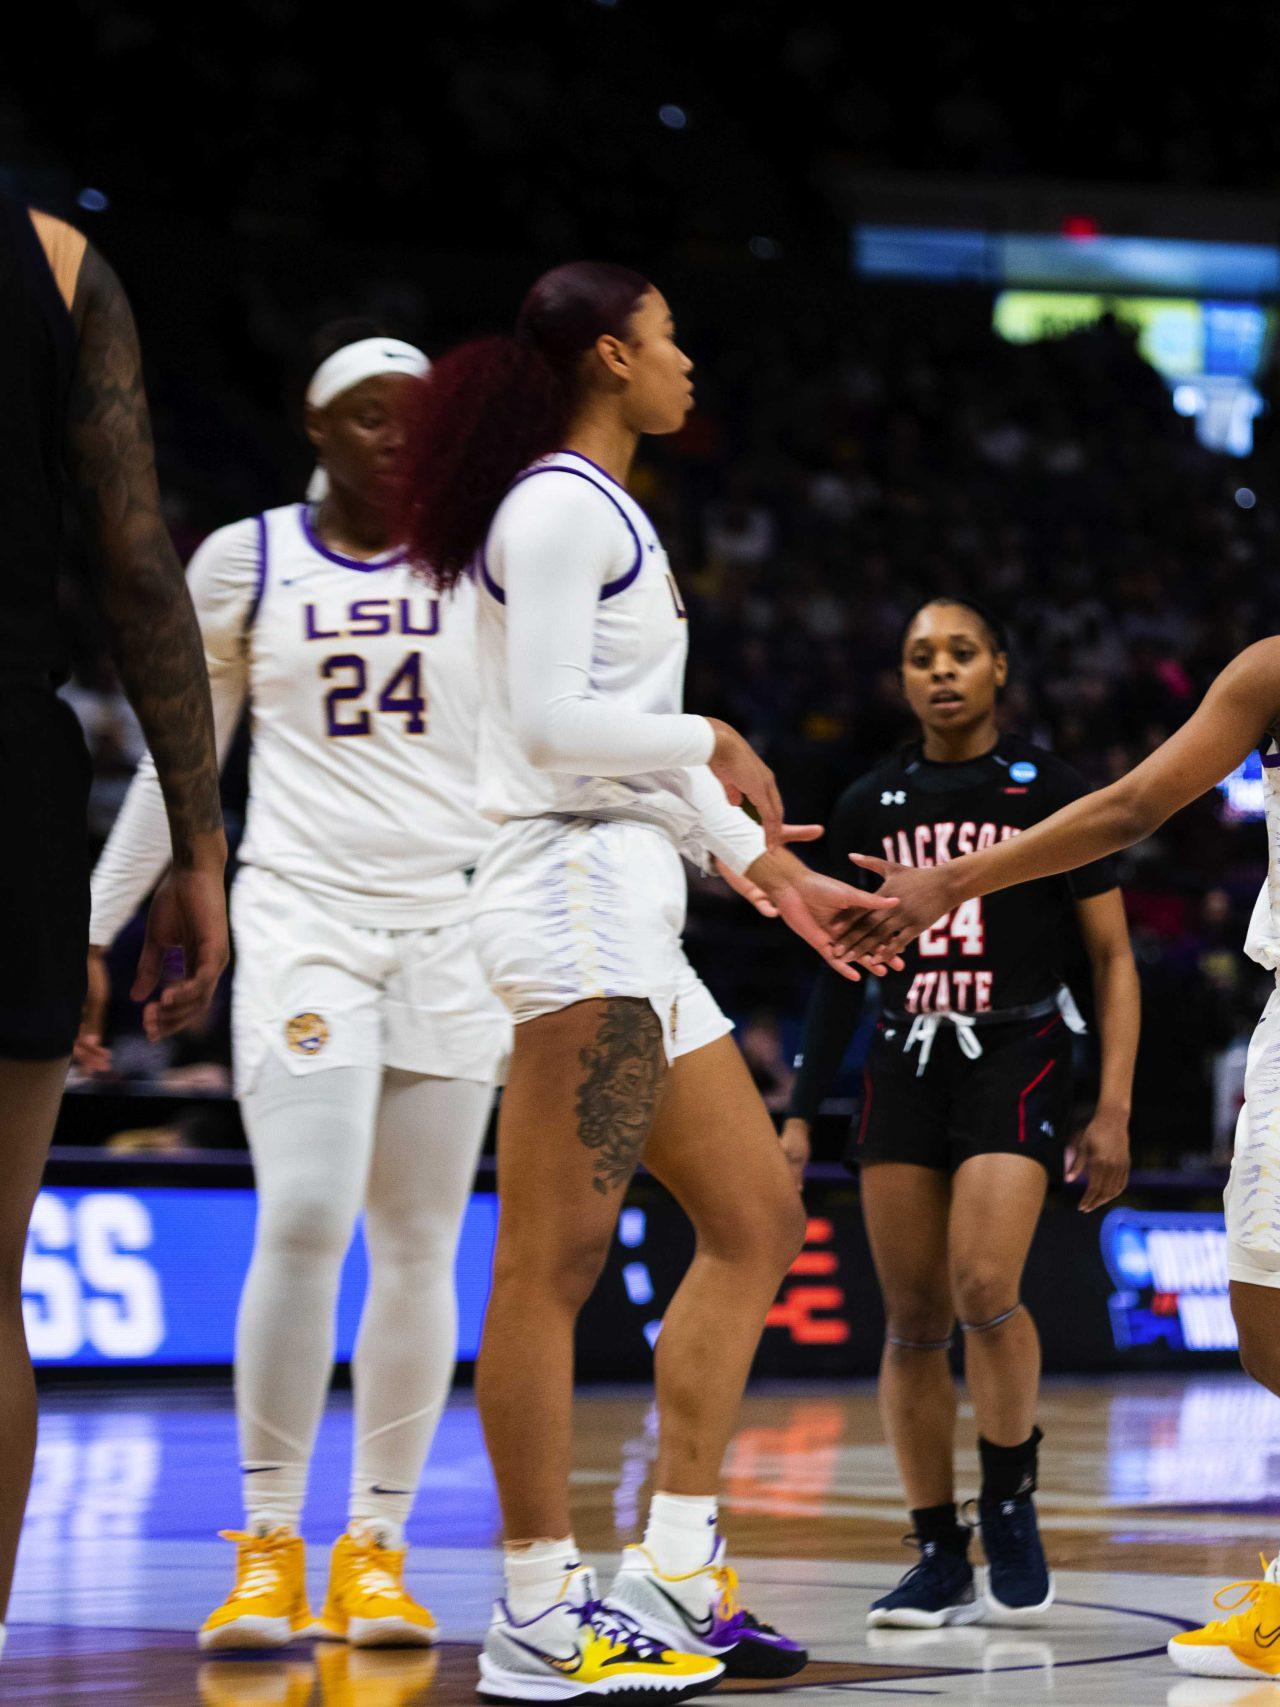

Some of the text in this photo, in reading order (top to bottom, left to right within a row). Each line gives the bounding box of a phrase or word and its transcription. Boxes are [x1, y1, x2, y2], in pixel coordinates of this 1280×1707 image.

[304, 598, 441, 641] LSU
[318, 651, 428, 738] 24
[904, 968, 994, 1014] STATE
